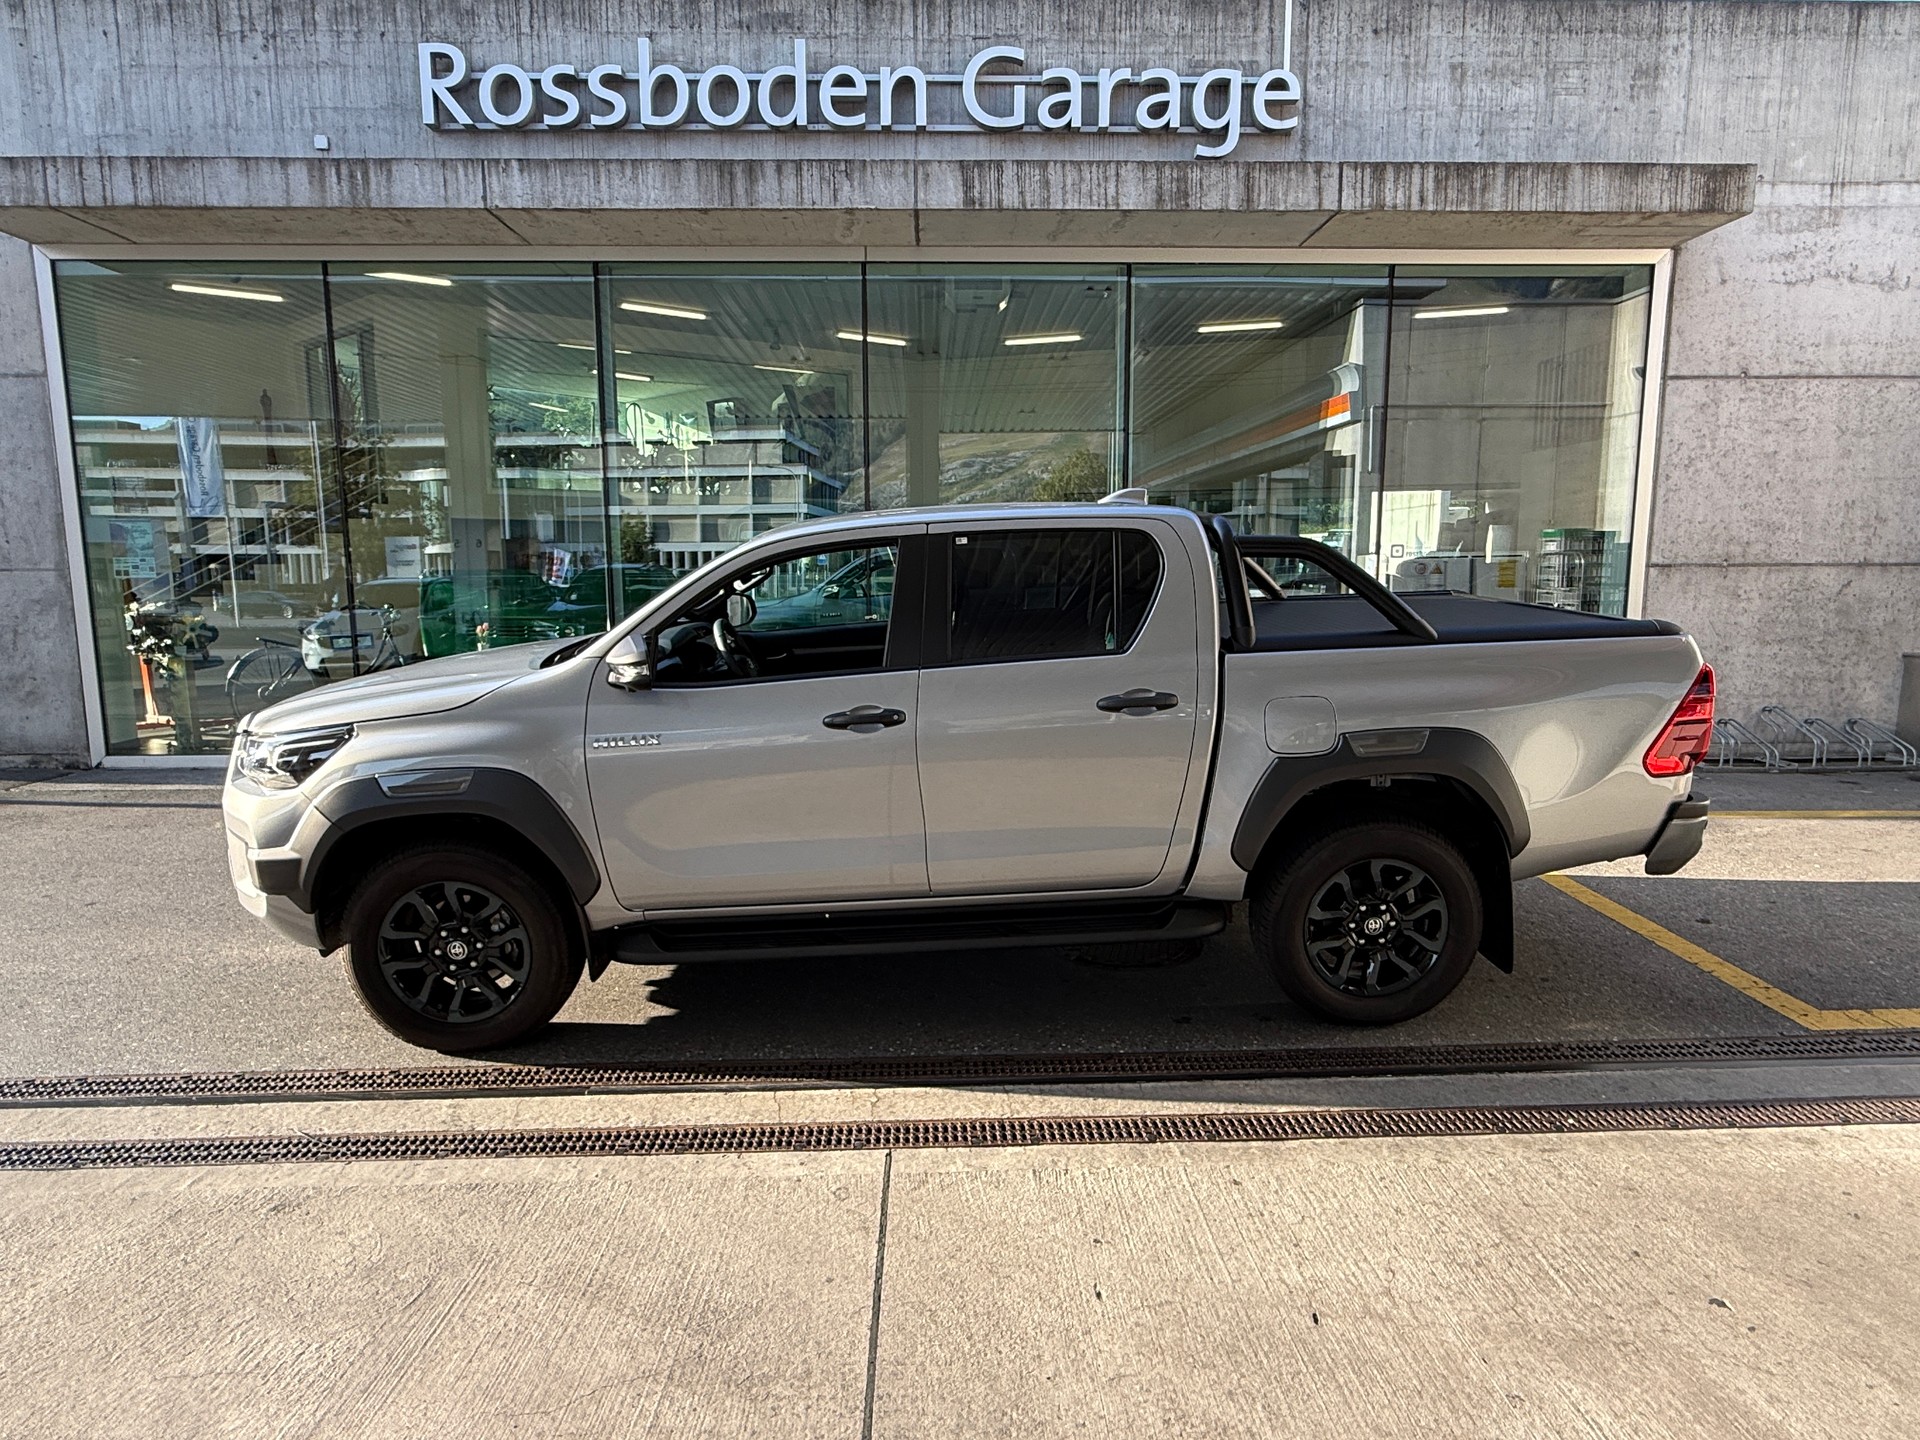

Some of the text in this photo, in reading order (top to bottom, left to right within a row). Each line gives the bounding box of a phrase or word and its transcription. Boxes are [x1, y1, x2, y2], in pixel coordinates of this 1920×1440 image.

[418, 37, 1301, 159] Rossboden Garage
[592, 734, 661, 748] HILUX
